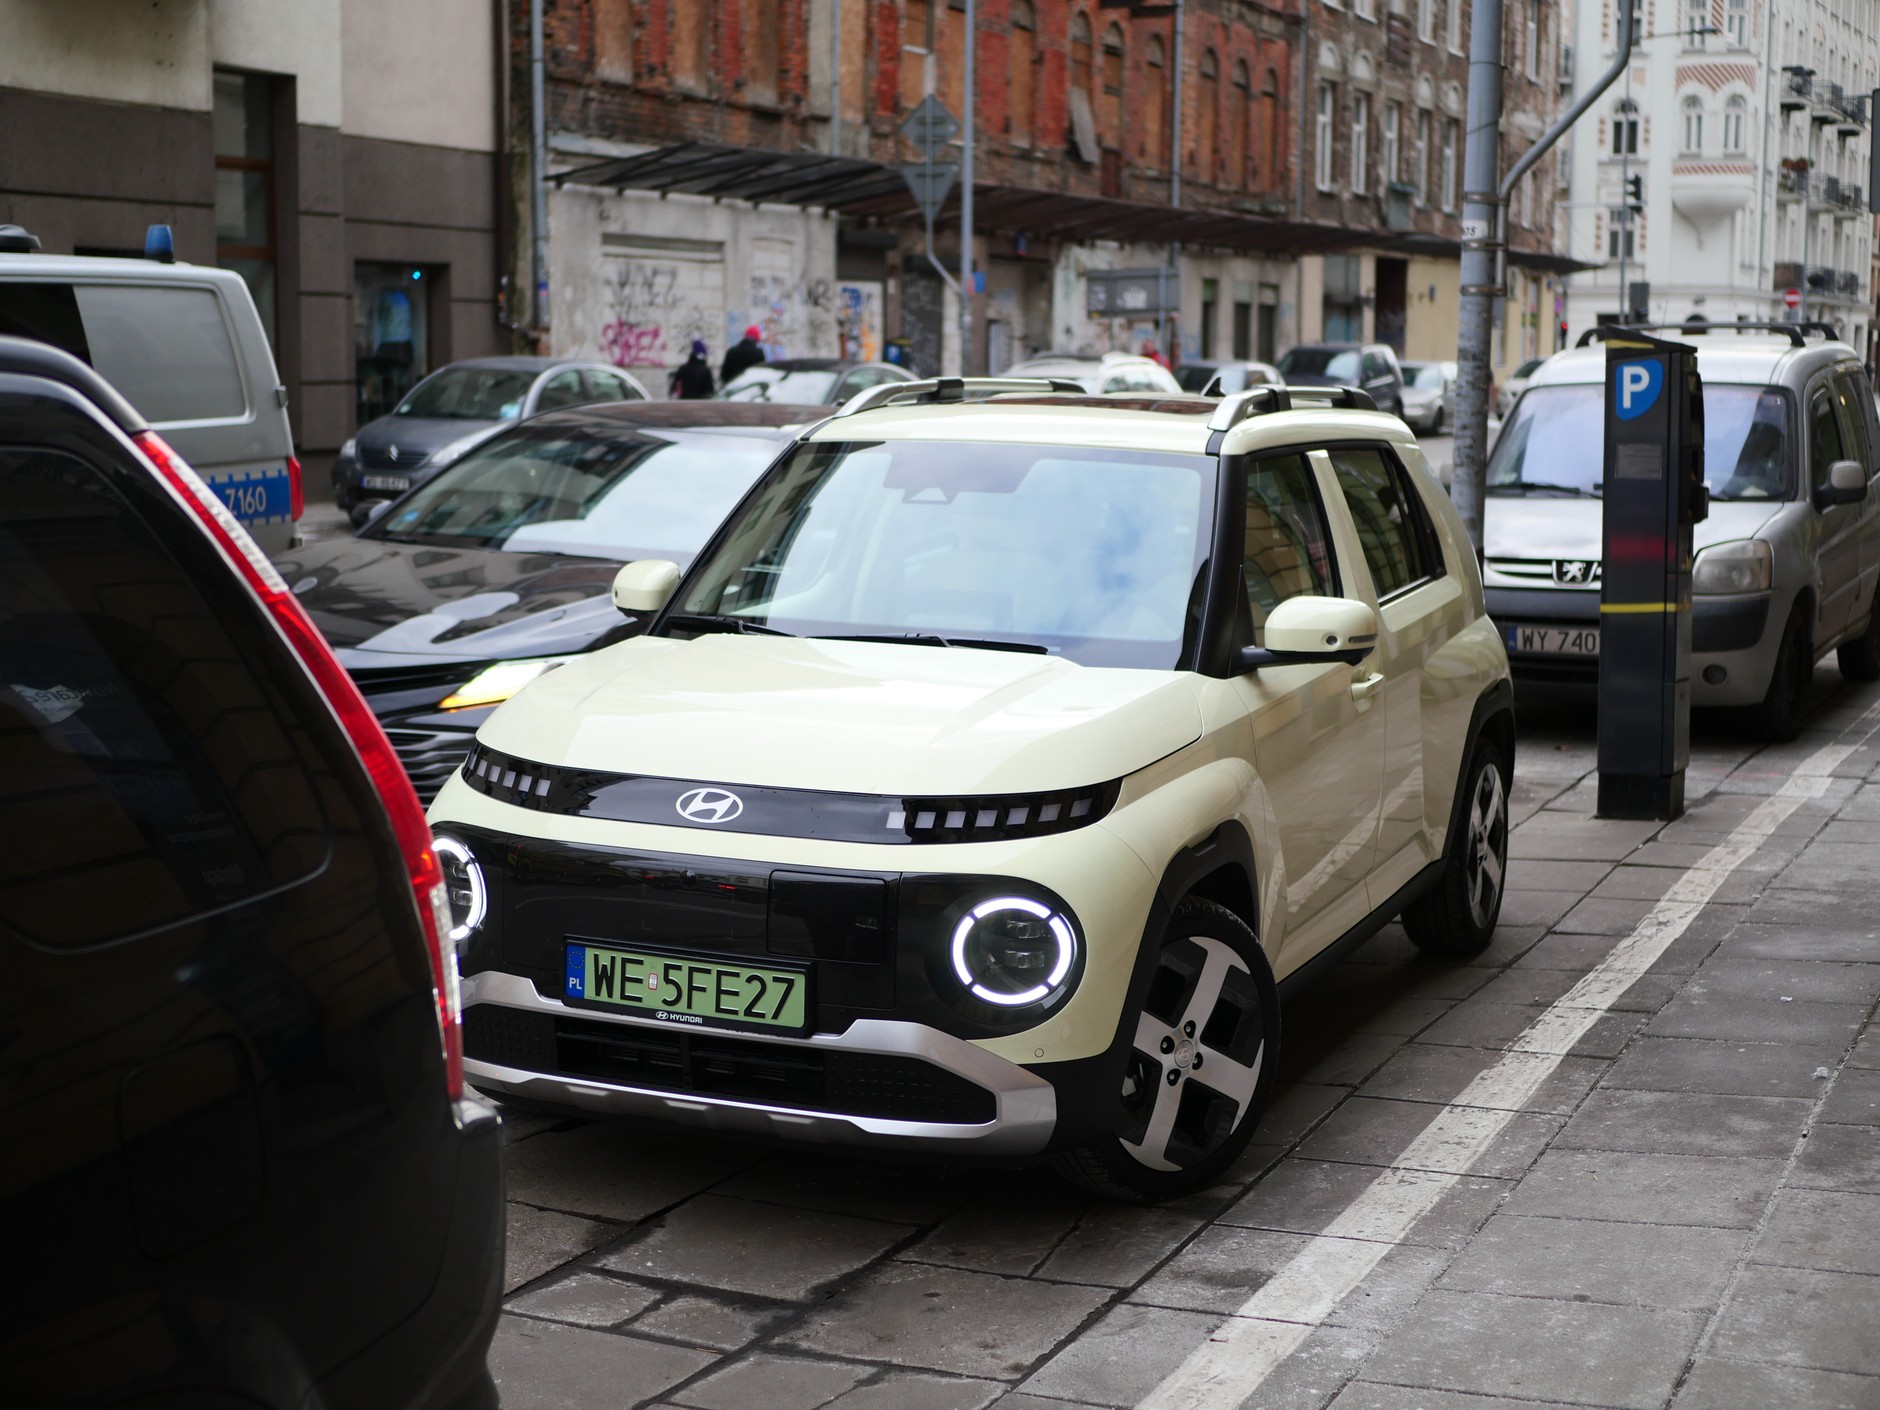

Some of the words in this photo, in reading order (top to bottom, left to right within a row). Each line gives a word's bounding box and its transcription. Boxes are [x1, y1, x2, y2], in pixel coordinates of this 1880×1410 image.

[1623, 365, 1650, 409] P
[225, 485, 266, 515] Z160
[1522, 629, 1548, 651] WY
[1557, 631, 1600, 653] 740
[569, 977, 582, 990] PL
[593, 952, 644, 1003] WE
[661, 961, 795, 1020] 5FE27
[670, 1013, 703, 1024] HYUNDAI
